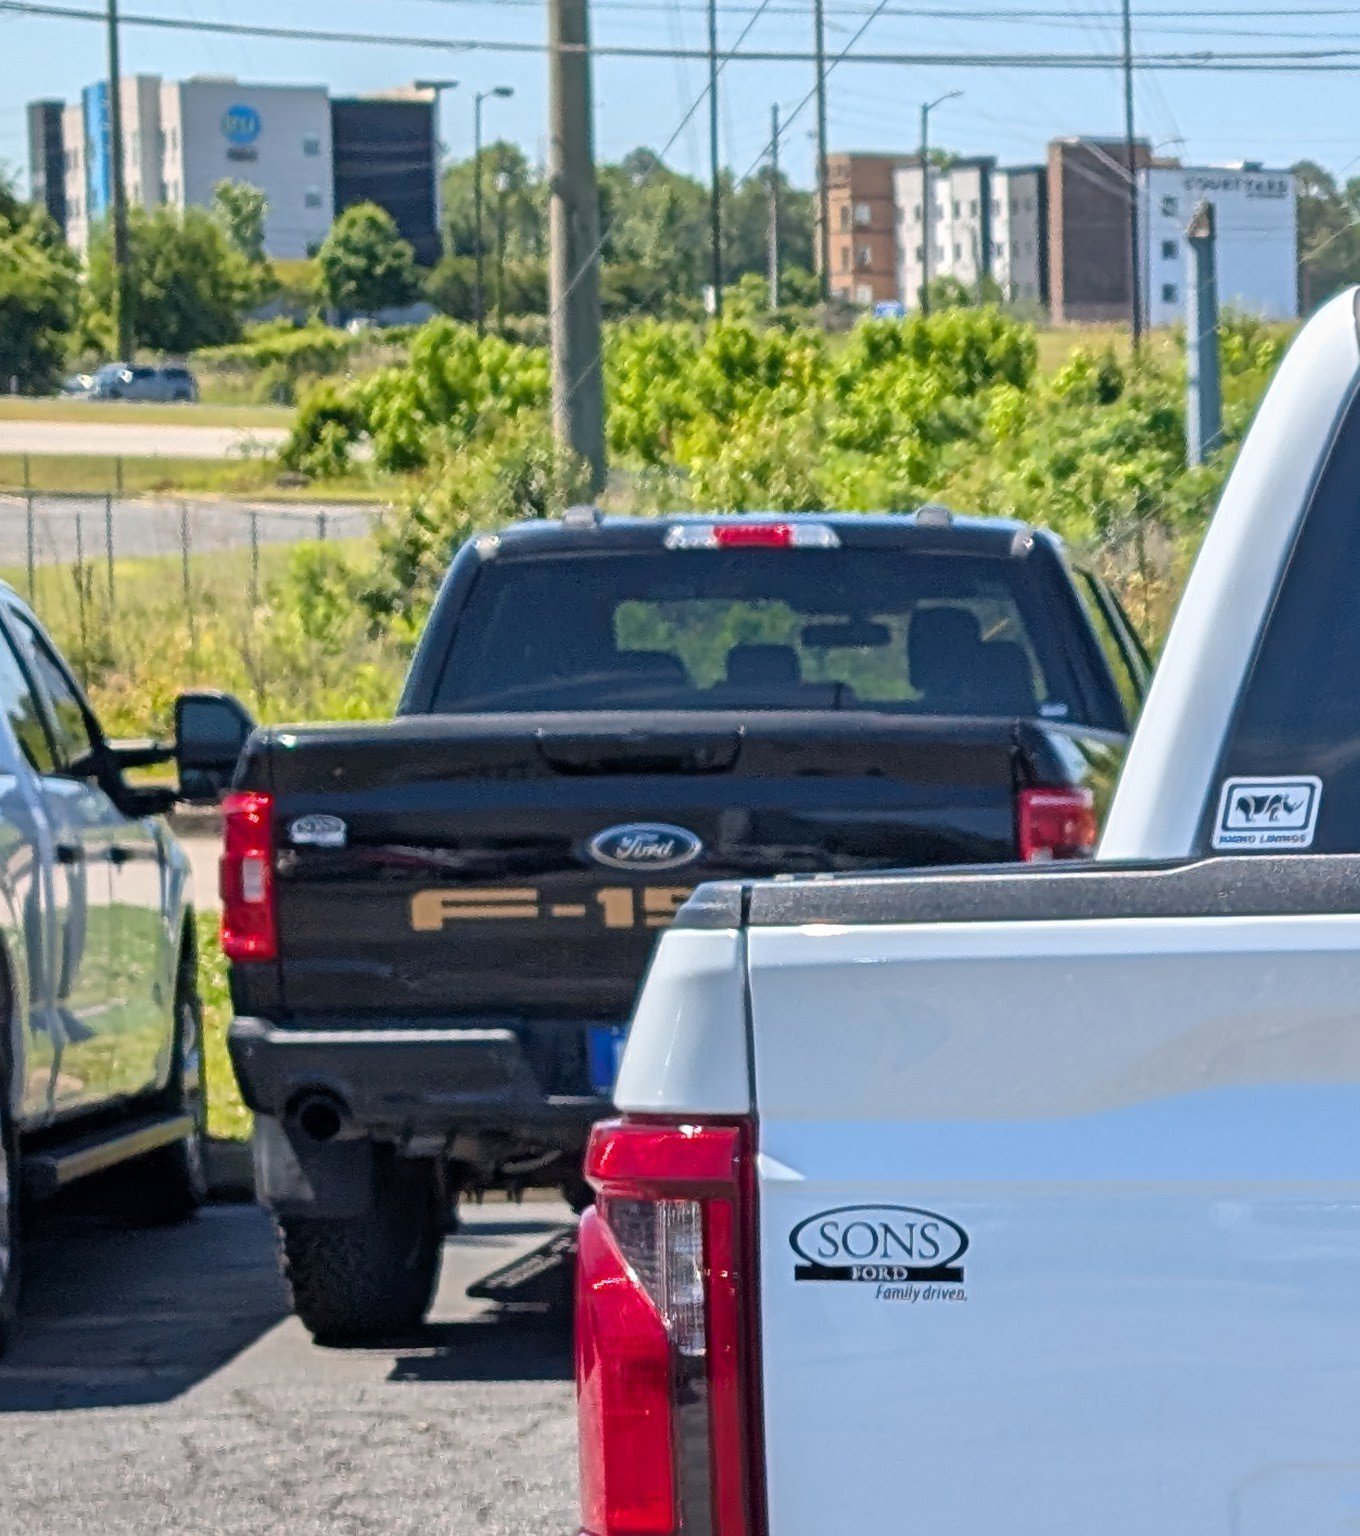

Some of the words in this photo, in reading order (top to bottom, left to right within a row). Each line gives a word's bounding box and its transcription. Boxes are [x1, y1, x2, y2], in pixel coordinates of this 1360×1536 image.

[614, 832, 675, 859] Ford
[817, 1221, 941, 1260] SONS
[851, 1266, 909, 1281] FORD
[874, 1284, 921, 1304] Family
